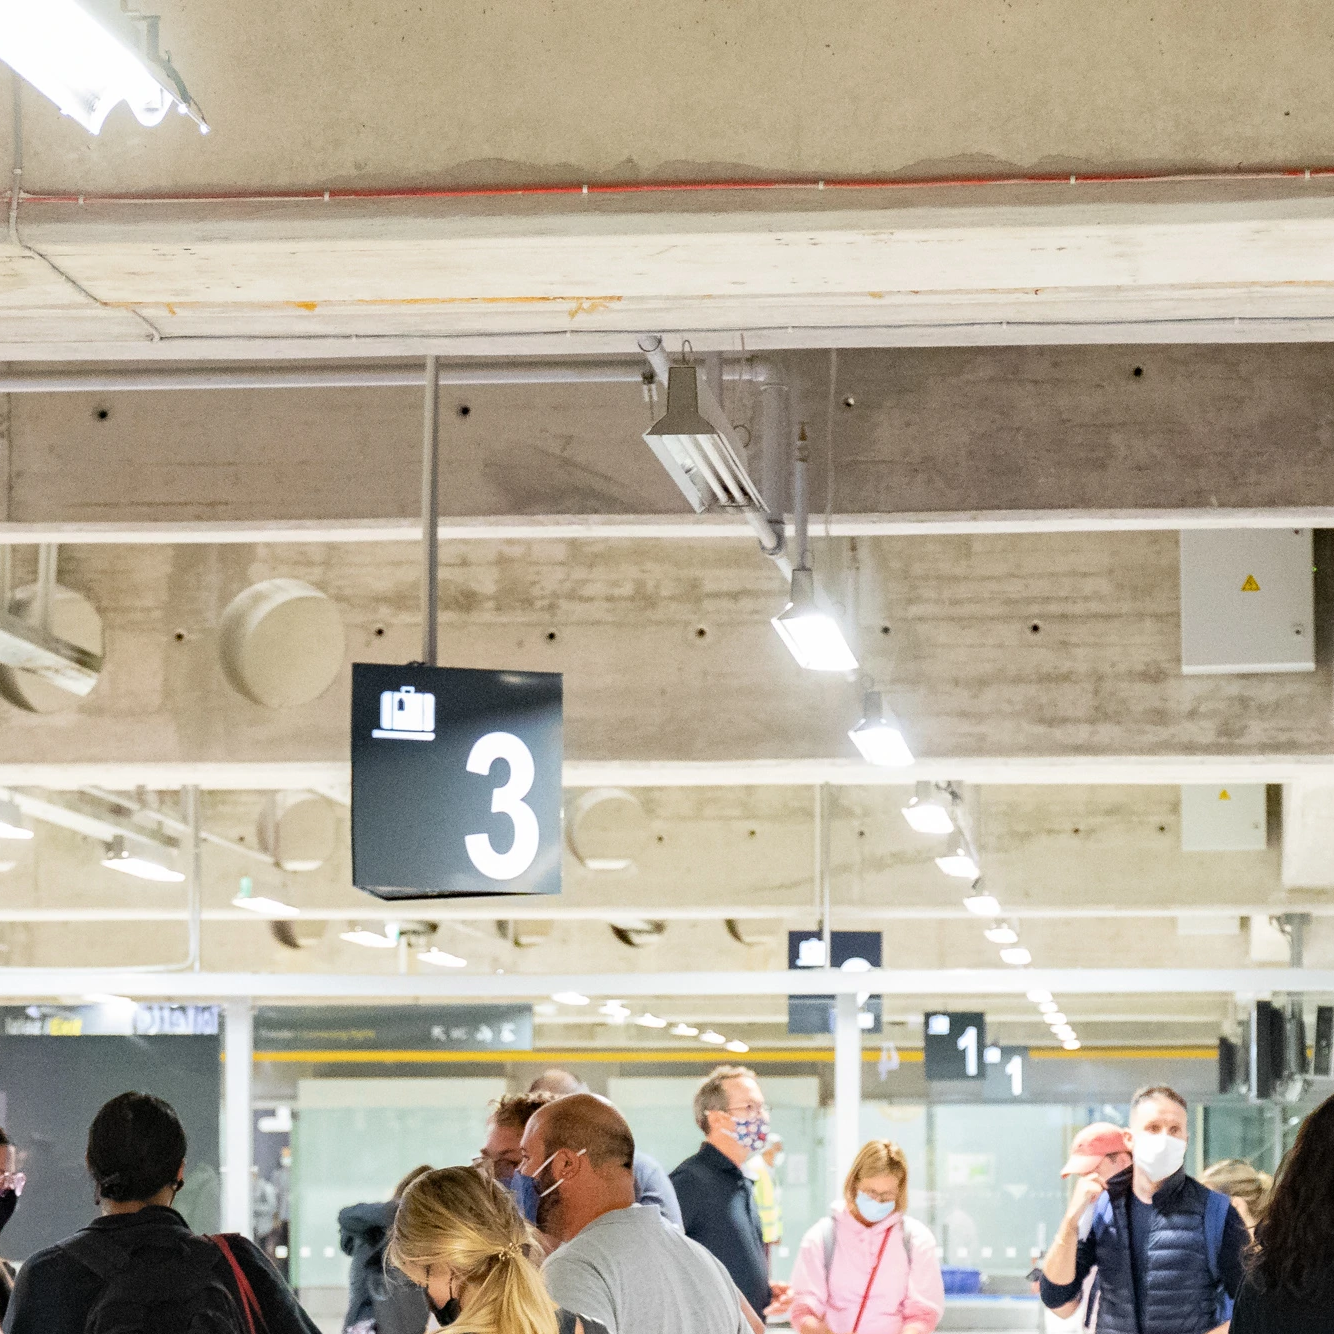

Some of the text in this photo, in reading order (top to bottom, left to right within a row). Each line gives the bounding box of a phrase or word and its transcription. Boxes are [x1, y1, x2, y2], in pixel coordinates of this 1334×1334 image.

[465, 731, 539, 880] 3
[957, 1026, 978, 1076] 1
[1005, 1055, 1022, 1095] 1
